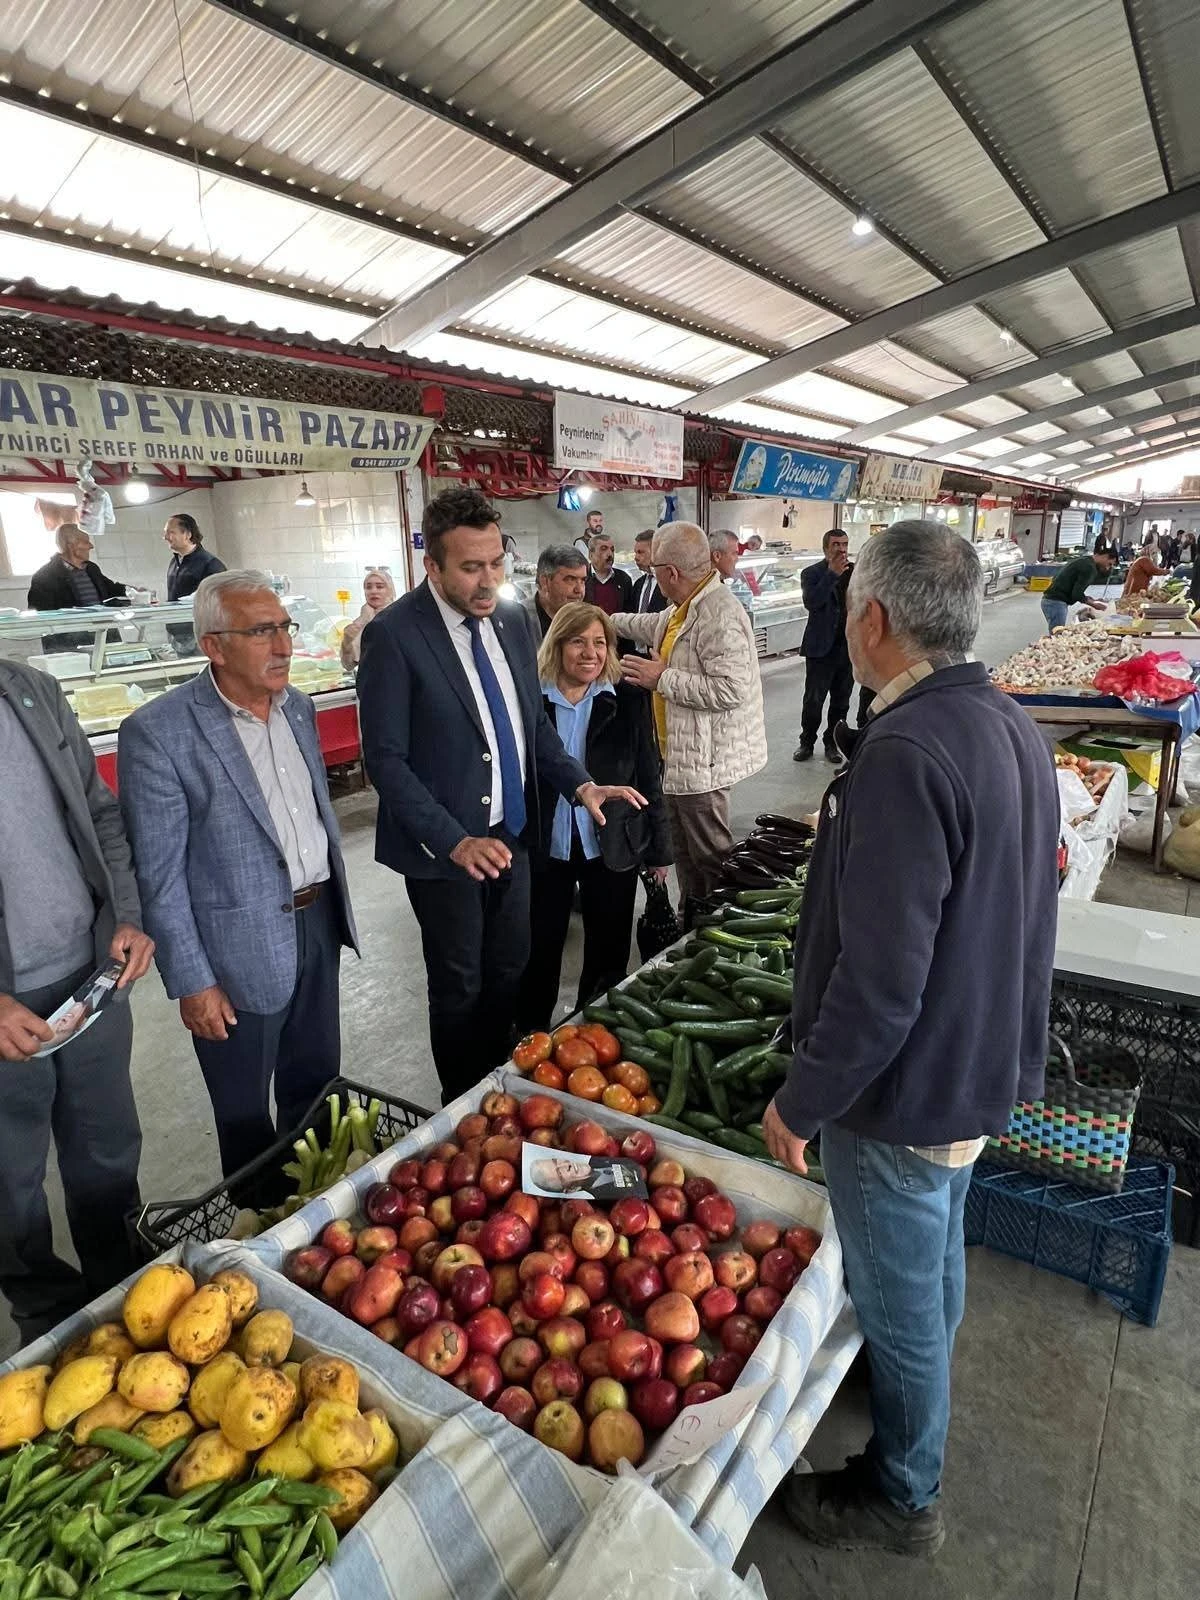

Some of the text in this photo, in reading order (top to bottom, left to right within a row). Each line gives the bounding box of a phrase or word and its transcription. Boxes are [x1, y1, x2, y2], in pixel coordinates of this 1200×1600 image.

[299, 411, 423, 451] PAZARI
[145, 442, 204, 462] ORHAN
[210, 451, 228, 462] ve
[234, 445, 303, 466] OĞULLARI
